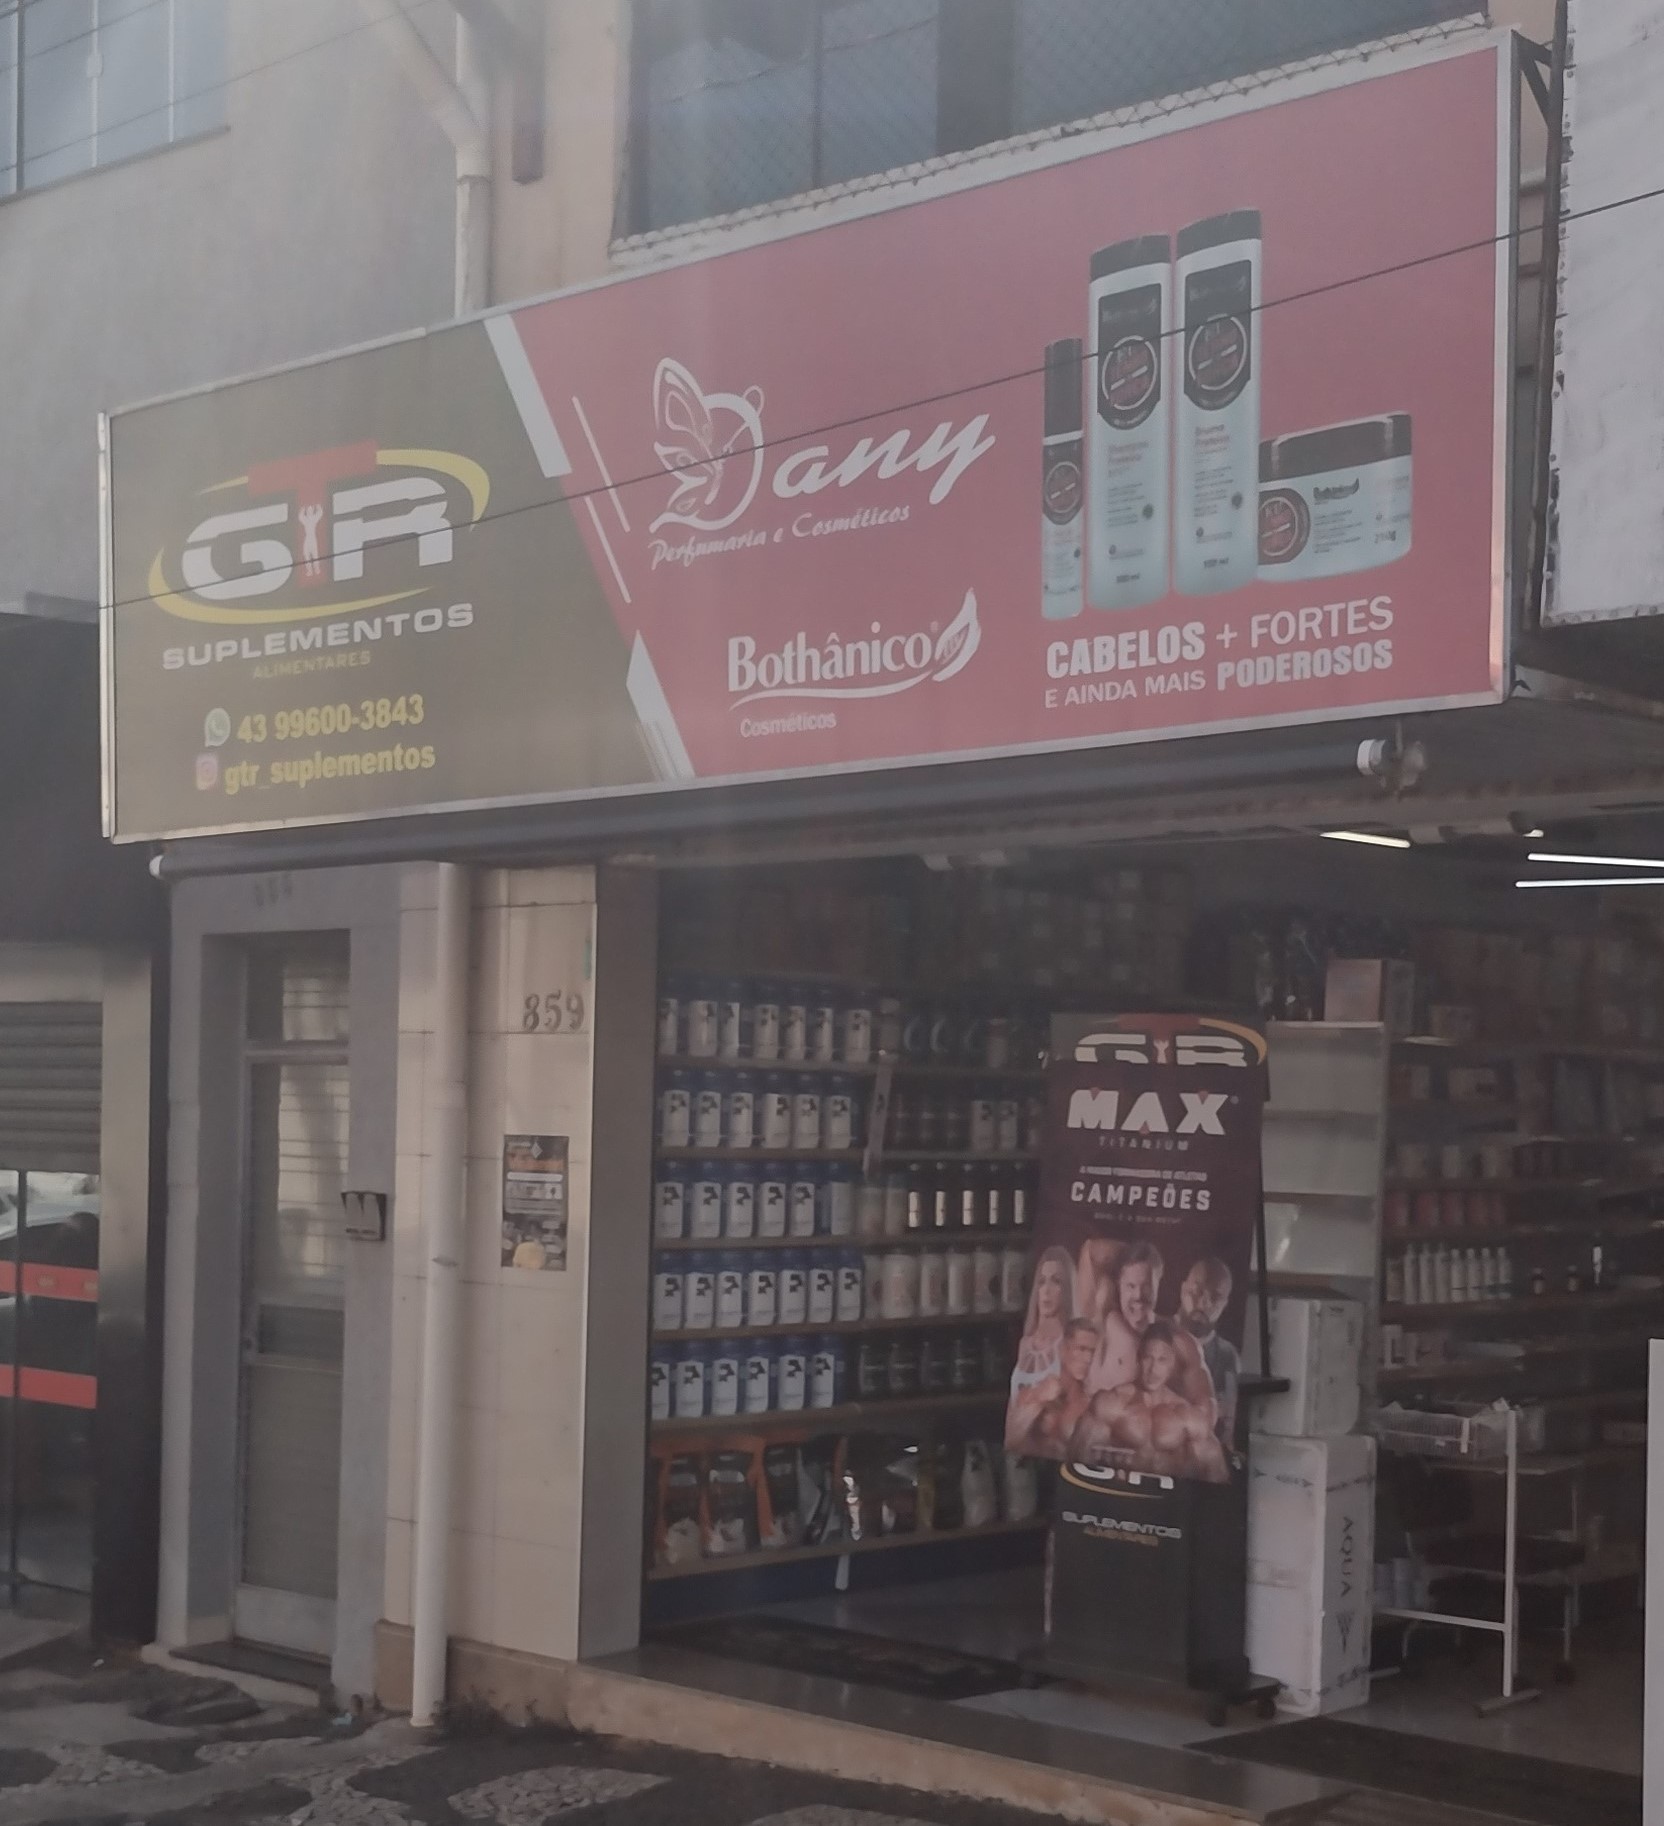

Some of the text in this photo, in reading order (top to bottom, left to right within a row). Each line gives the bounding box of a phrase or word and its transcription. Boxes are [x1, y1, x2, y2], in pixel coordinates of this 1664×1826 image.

[181, 439, 453, 600] GTR
[648, 505, 910, 570] Perfumaria e Cosméticos
[162, 602, 474, 670] SUPLEMENTOS
[728, 620, 932, 692] Bothânico
[1046, 621, 1206, 679] CABELOS
[1250, 595, 1394, 649] FORTES
[252, 650, 371, 680] ALIMENTARES
[1044, 639, 1393, 709] E AINDA MAIS PODEROSOS
[236, 693, 425, 744] 43 99600-3843
[740, 711, 837, 738] Cosméticos
[223, 742, 436, 795] gtr_suplementos
[522, 990, 585, 1033] 859
[1066, 1088, 1229, 1136] MAX
[1099, 1136, 1189, 1151] TITANIUM
[1070, 1180, 1212, 1212] CAMPEÕES
[1340, 1515, 1354, 1597] AQUA
